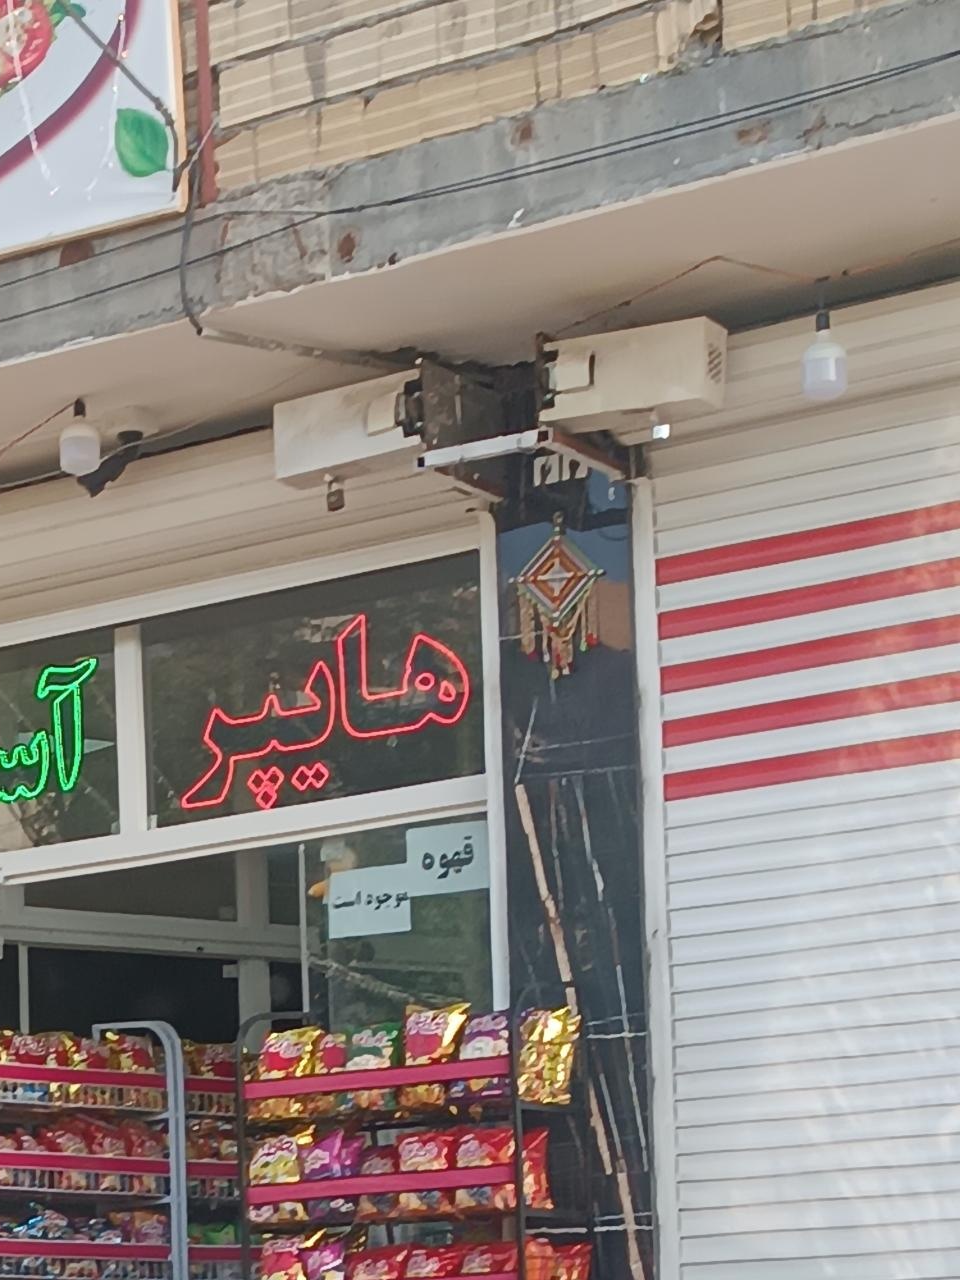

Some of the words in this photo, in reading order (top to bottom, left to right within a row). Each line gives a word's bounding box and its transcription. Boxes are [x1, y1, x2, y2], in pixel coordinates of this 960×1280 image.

[181, 613, 474, 810] هایپر
[420, 835, 474, 880] قهوه
[332, 889, 362, 910] است
[365, 891, 410, 911] موجود
